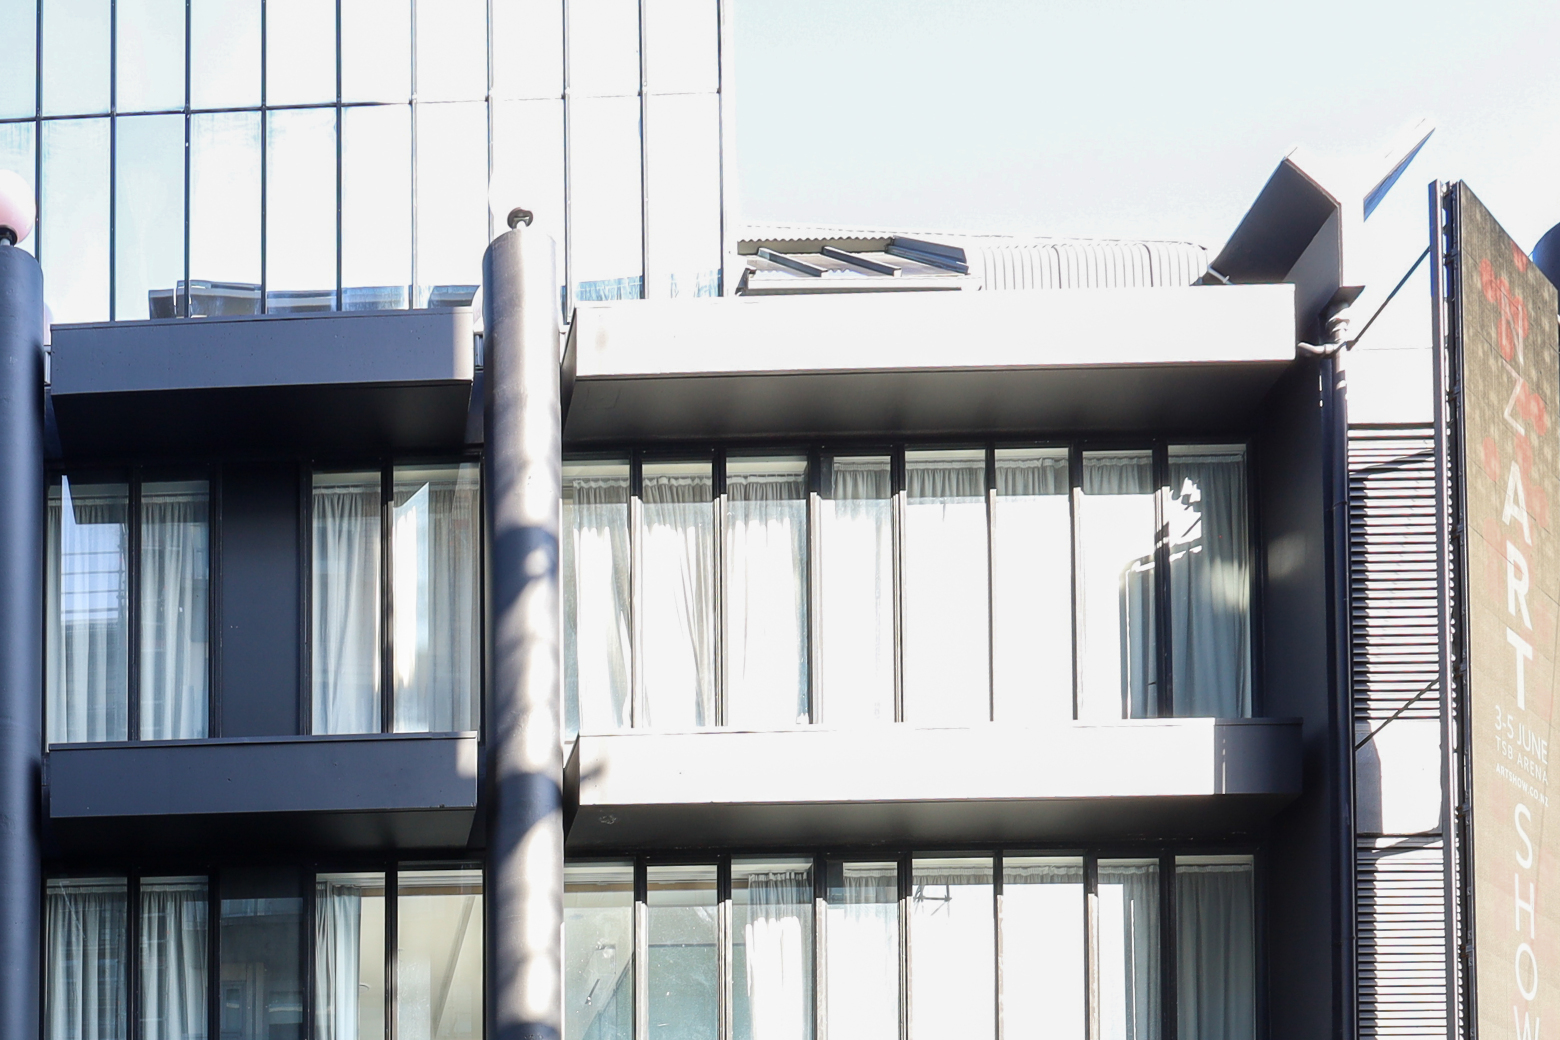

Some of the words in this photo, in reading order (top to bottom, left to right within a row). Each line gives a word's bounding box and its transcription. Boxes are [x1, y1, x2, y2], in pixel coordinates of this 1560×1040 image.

[1495, 705, 1514, 739] 3-5
[1517, 723, 1547, 765] JUNE
[1495, 735, 1513, 760] TSB
[1517, 752, 1548, 786] ARENA
[1496, 763, 1549, 807] ARTSHOW.CO.NZ
